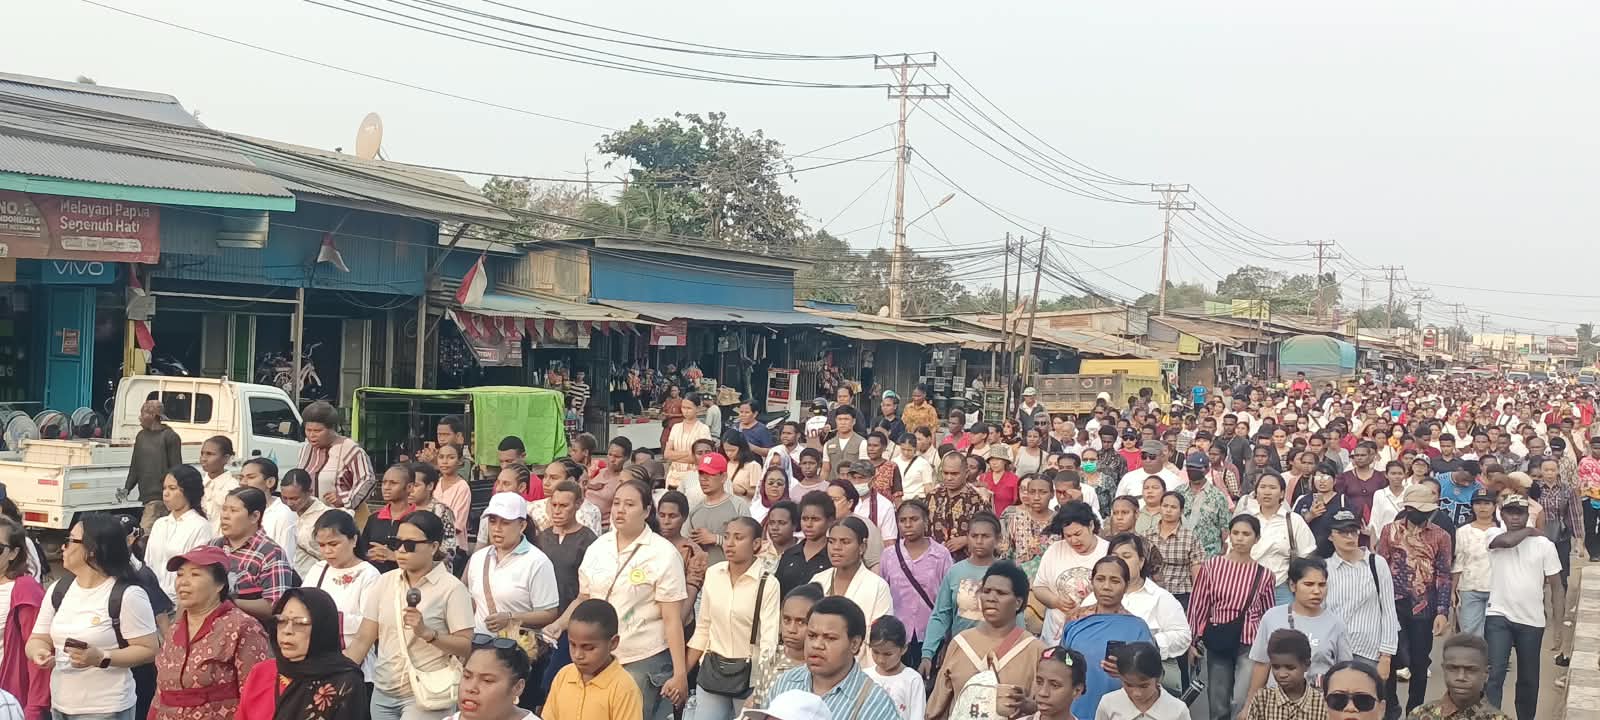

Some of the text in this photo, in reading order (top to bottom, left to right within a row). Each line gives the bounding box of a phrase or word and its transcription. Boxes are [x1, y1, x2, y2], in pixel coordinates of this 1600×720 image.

[60, 199, 151, 220] Melayani Papua
[59, 215, 113, 232] Sepenuh
[115, 218, 140, 233] Hati
